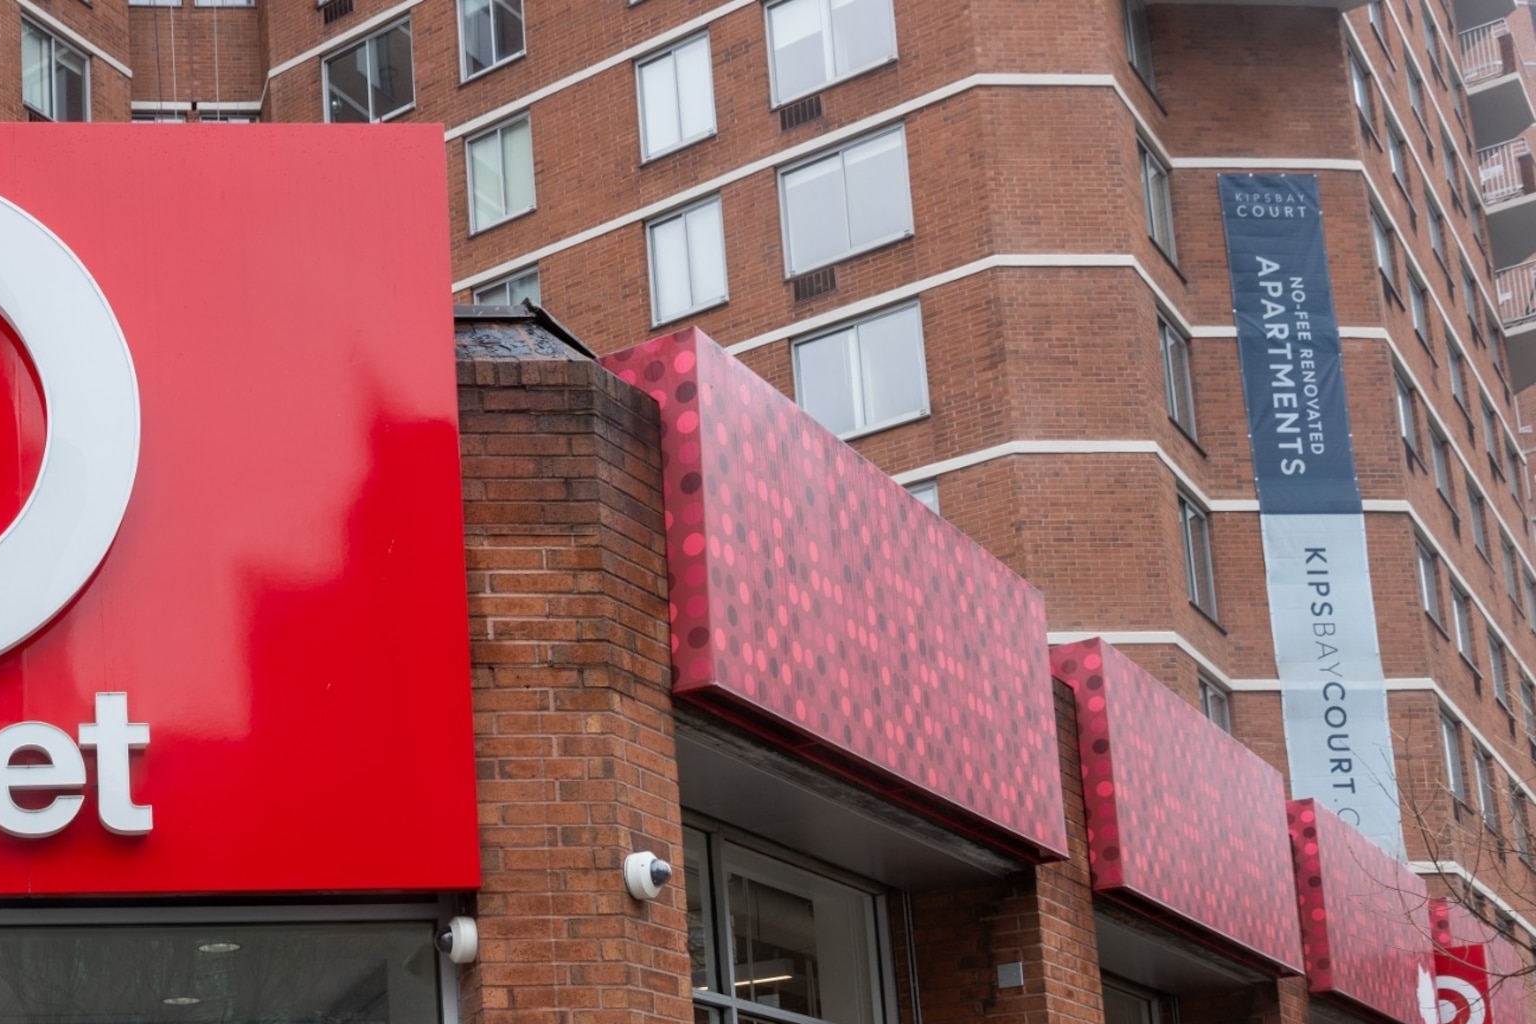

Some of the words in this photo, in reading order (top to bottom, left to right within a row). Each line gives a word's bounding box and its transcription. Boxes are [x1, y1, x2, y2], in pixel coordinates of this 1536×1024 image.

[1235, 192, 1306, 204] KIPSBAY
[1236, 204, 1307, 218] COURT
[1289, 277, 1312, 341] NO-FEE
[1255, 256, 1307, 476] APARTMENTS
[1299, 349, 1325, 455] RENOVATED
